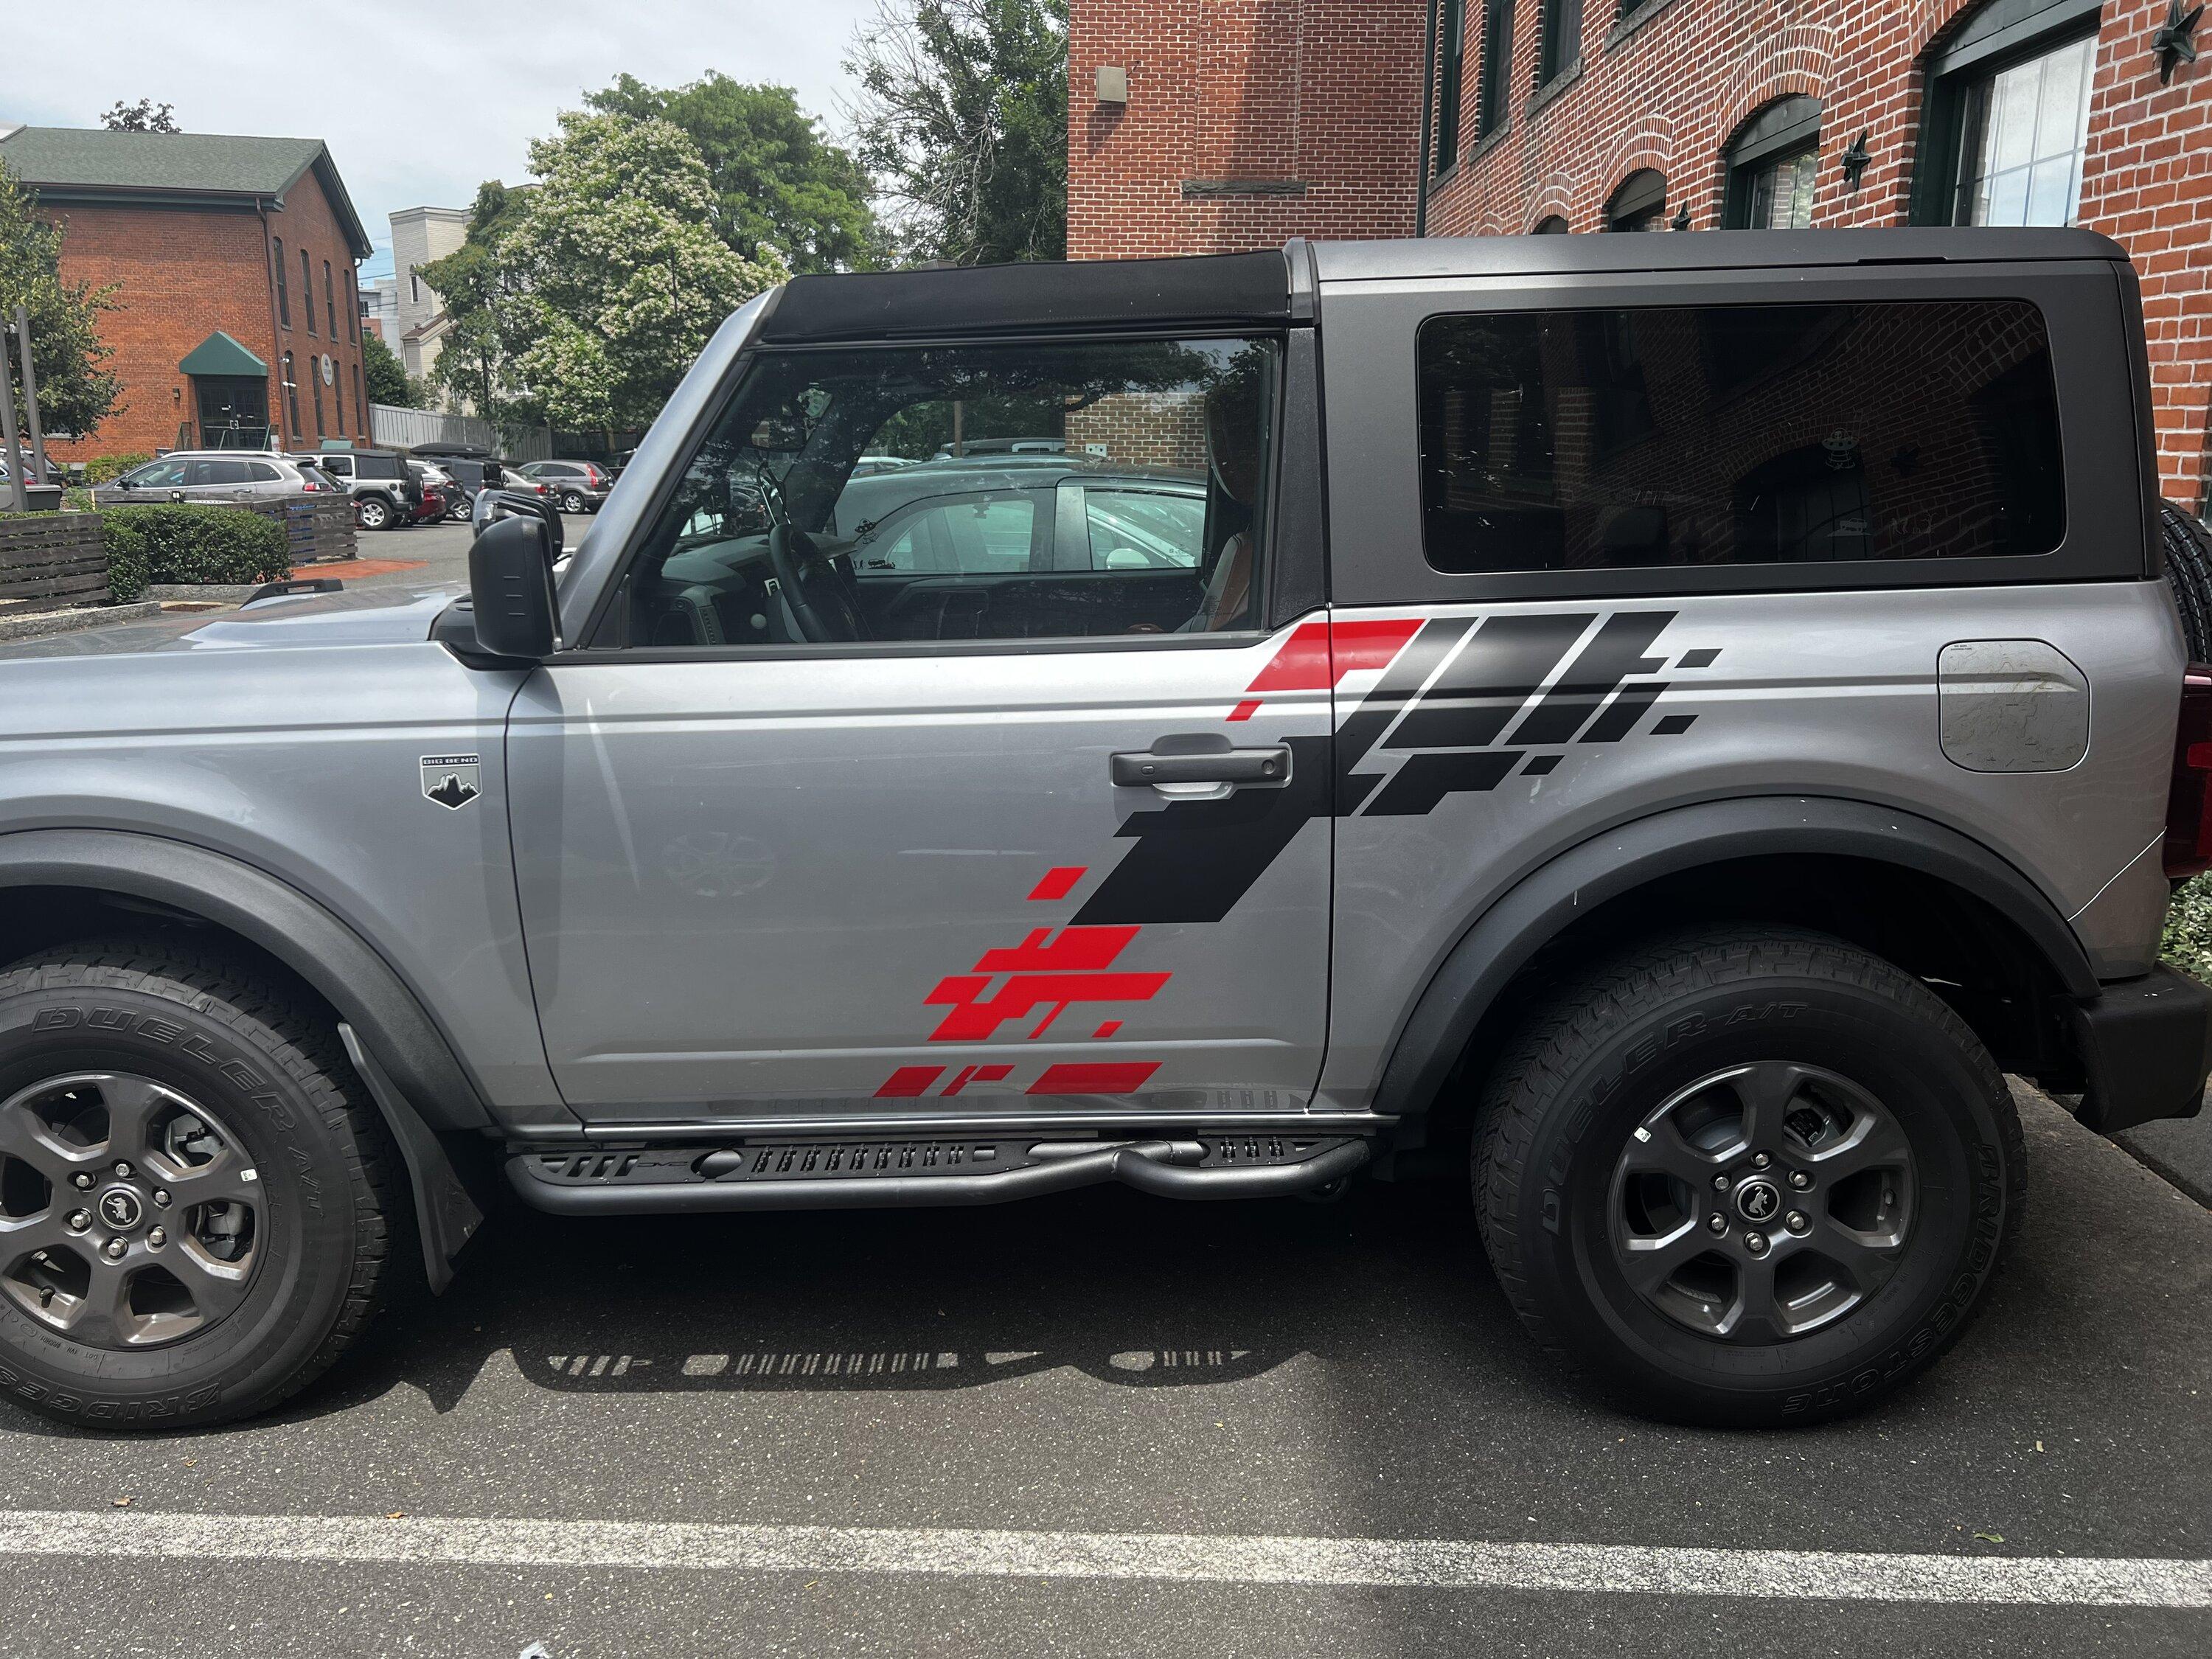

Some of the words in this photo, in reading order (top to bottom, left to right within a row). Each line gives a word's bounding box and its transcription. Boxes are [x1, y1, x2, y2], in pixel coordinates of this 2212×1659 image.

[31, 1004, 299, 1134] DUELER
[1541, 1010, 1710, 1237] DUELER
[1725, 1001, 1811, 1027] A/T
[1781, 1142, 2004, 1416] BRIDGESTONE
